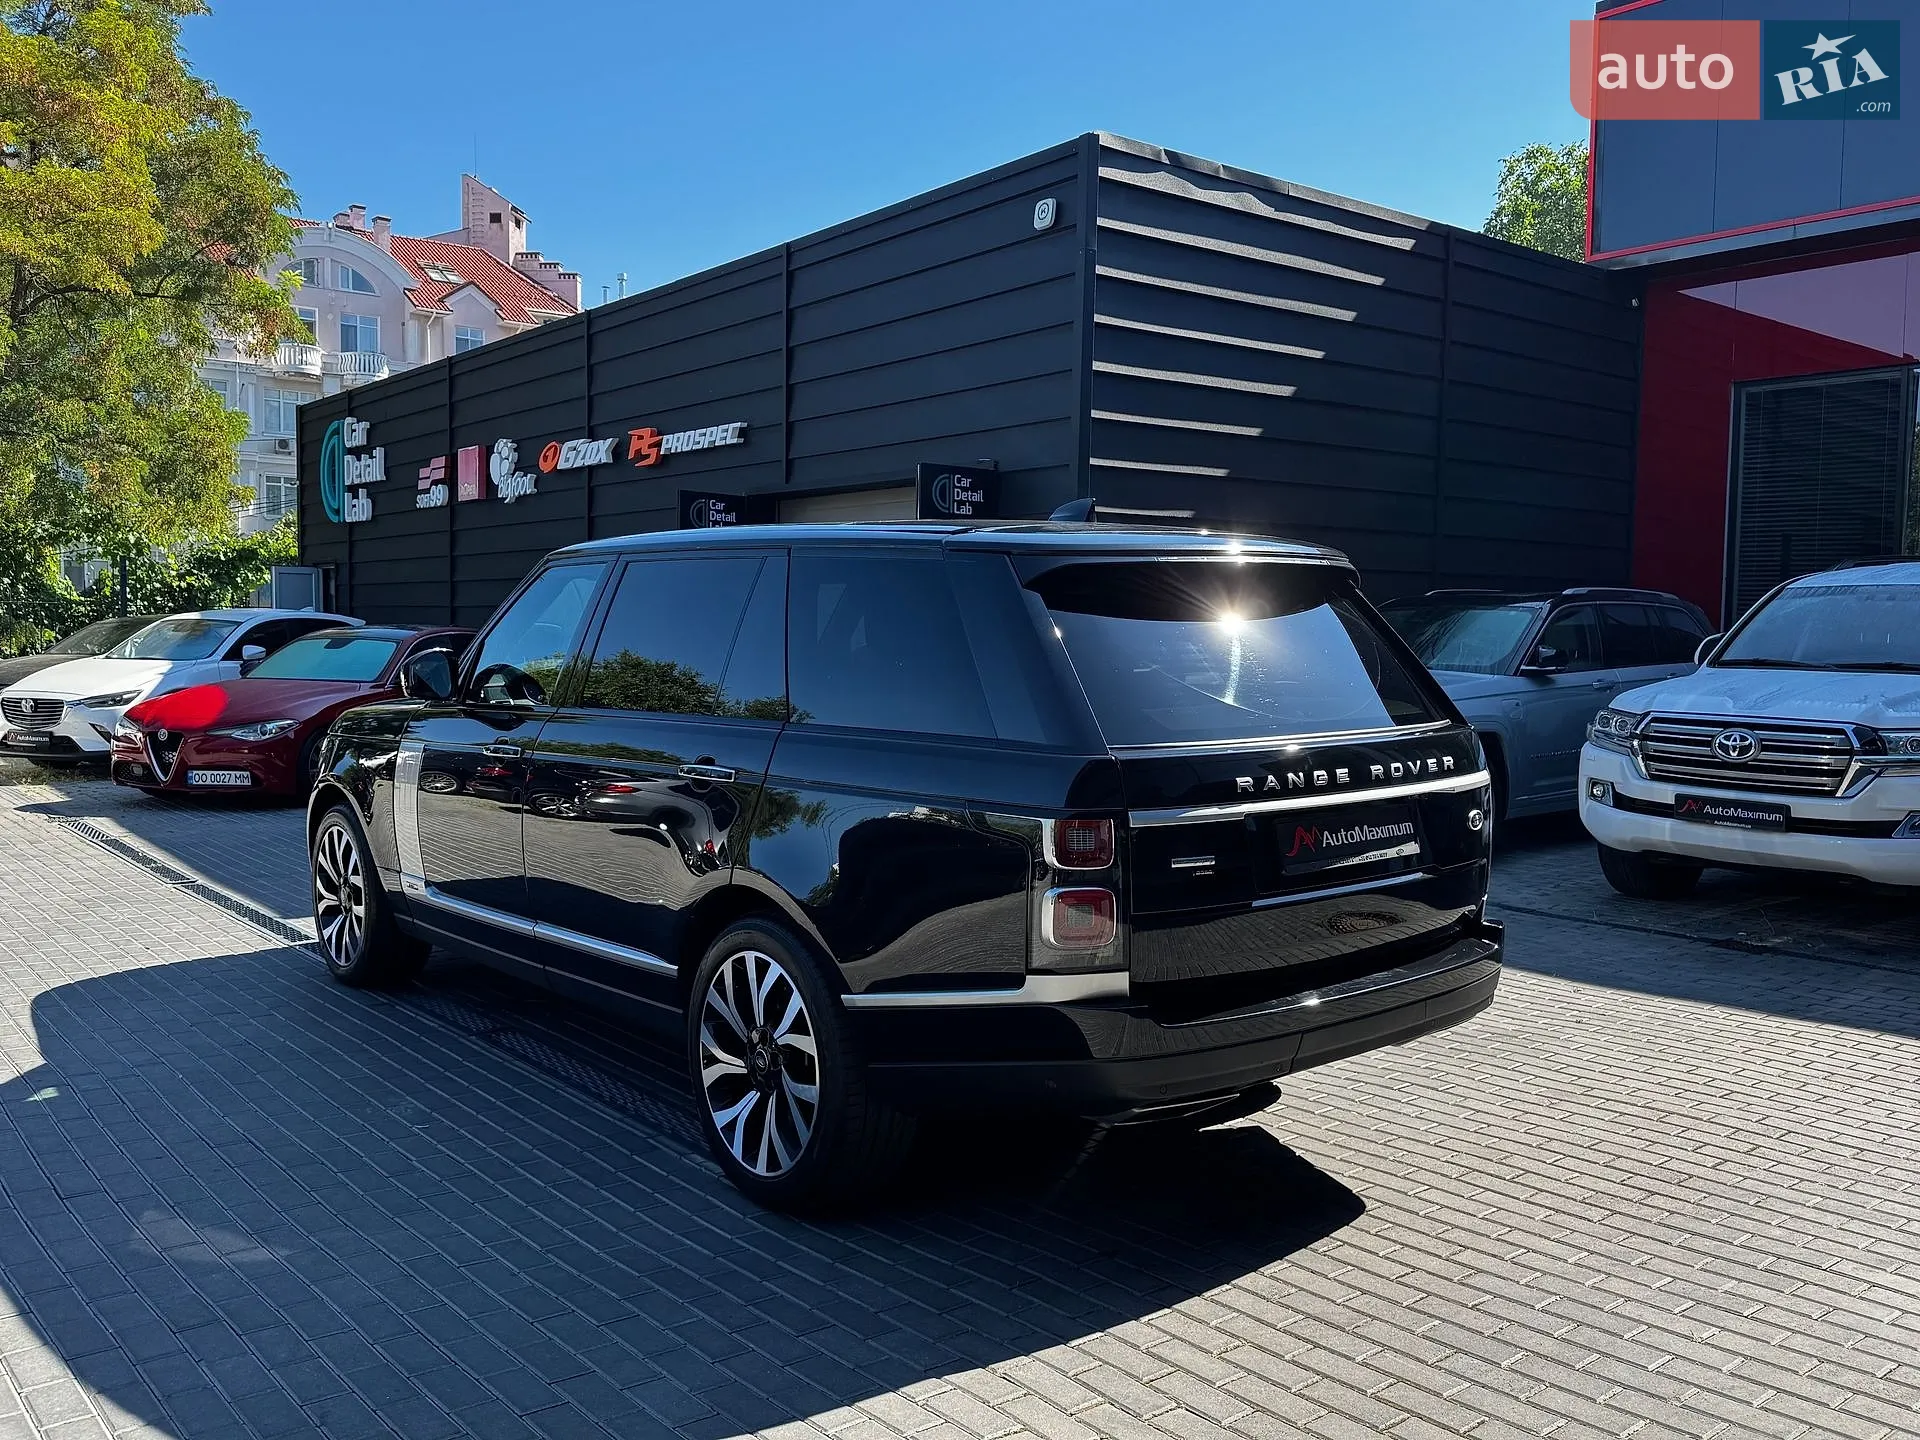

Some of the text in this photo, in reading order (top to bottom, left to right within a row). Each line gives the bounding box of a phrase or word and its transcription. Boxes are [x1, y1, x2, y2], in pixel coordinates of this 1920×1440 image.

[344, 417, 370, 448] Car
[660, 421, 748, 455] PROSPEC
[344, 447, 386, 485] Detail
[953, 474, 972, 488] Car
[953, 488, 984, 503] Detail
[344, 489, 372, 523] Lab
[709, 499, 726, 510] Car
[953, 501, 973, 515] Lab
[709, 510, 737, 523] Detail
[210, 771, 232, 785] 0027
[233, 772, 251, 786] MM
[1235, 755, 1455, 793] RANGE ROVER
[1703, 805, 1783, 821] AutoMaximum
[1321, 820, 1414, 848] AutoMaximum
